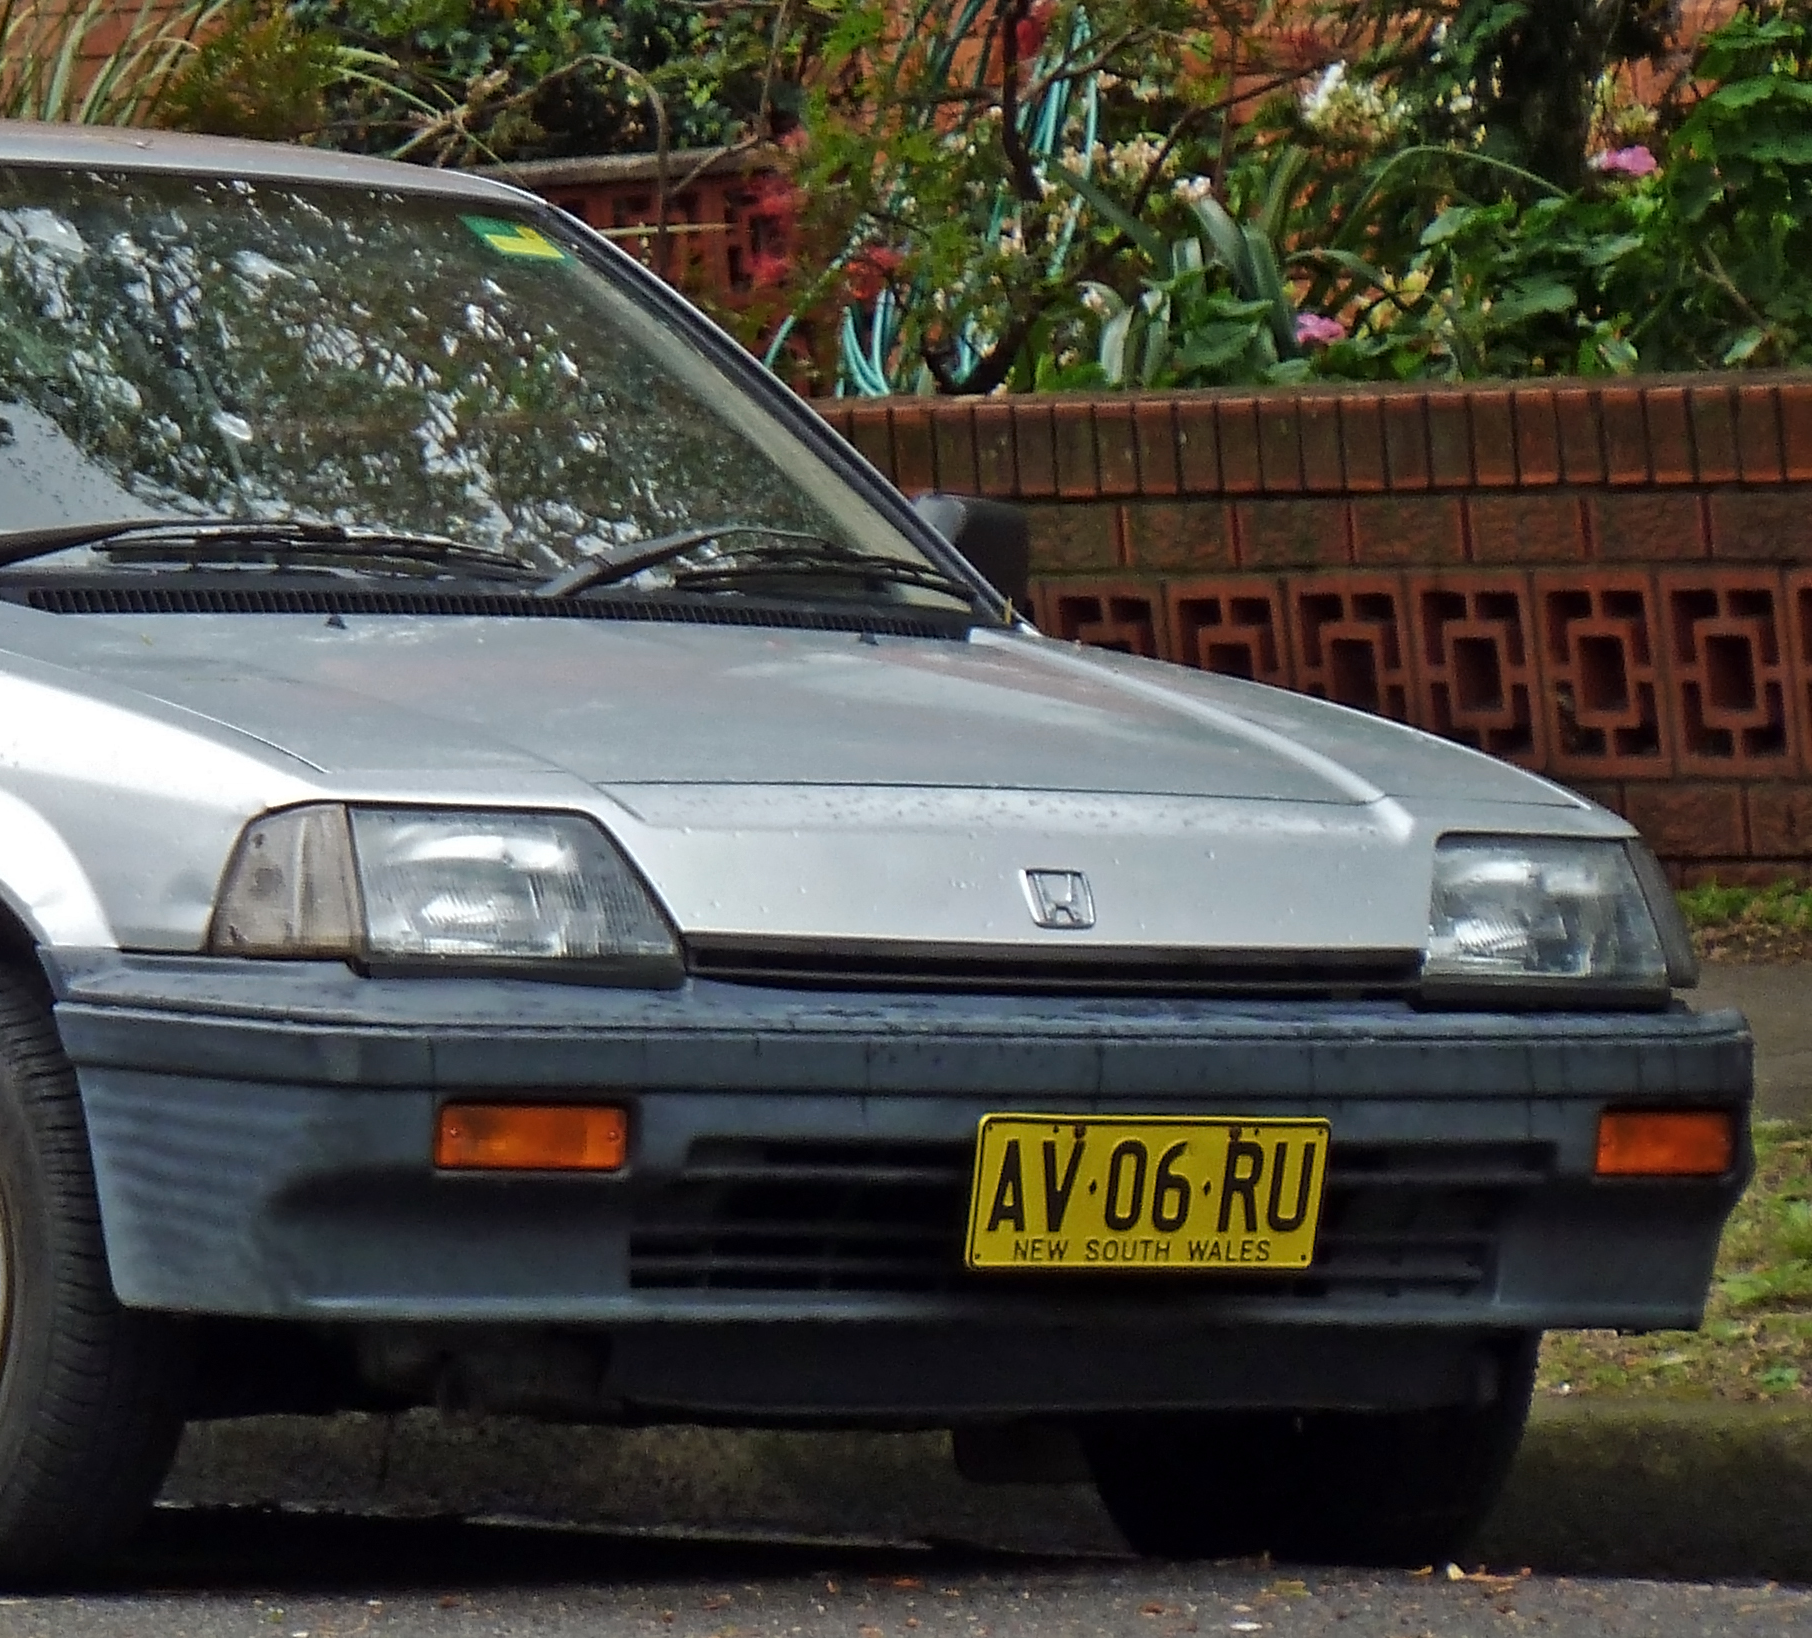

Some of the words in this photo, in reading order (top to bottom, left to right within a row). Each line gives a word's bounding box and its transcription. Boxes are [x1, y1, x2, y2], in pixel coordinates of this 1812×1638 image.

[1013, 1238, 1069, 1262] NEW
[1085, 1239, 1171, 1262] SOUTH
[1188, 1239, 1271, 1262] WALES
